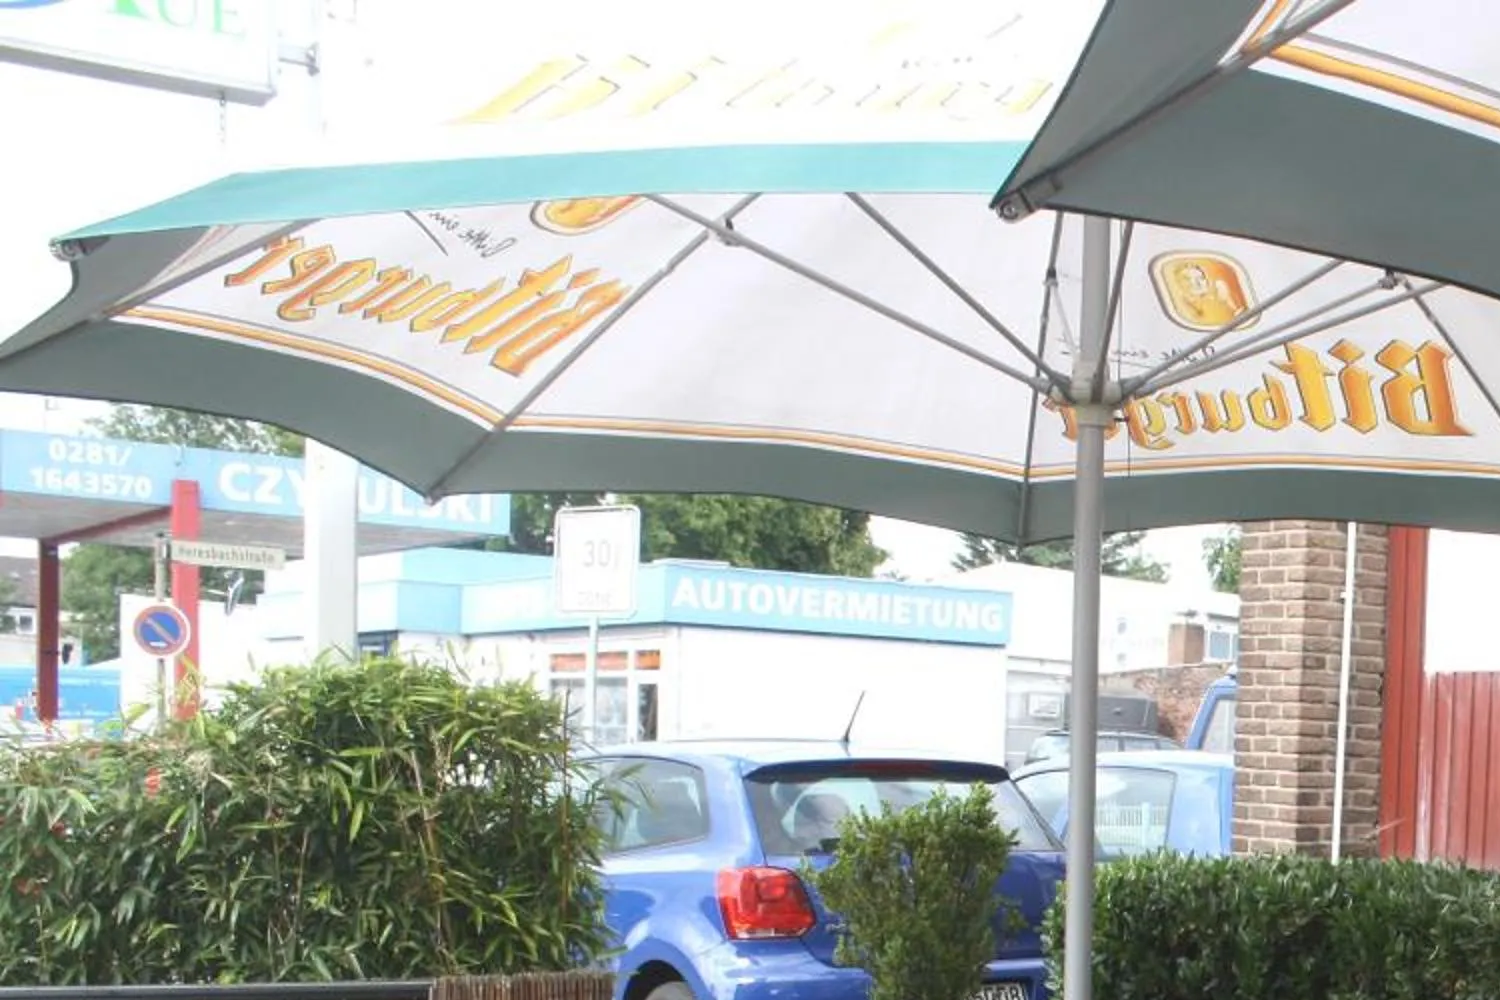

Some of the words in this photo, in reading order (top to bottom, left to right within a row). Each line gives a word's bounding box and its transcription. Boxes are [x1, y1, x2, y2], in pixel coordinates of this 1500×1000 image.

[48, 437, 133, 466] 0281/
[30, 464, 154, 499] 1643570
[582, 539, 612, 568] 30
[672, 577, 1004, 632] AUTOVERMIETUNG
